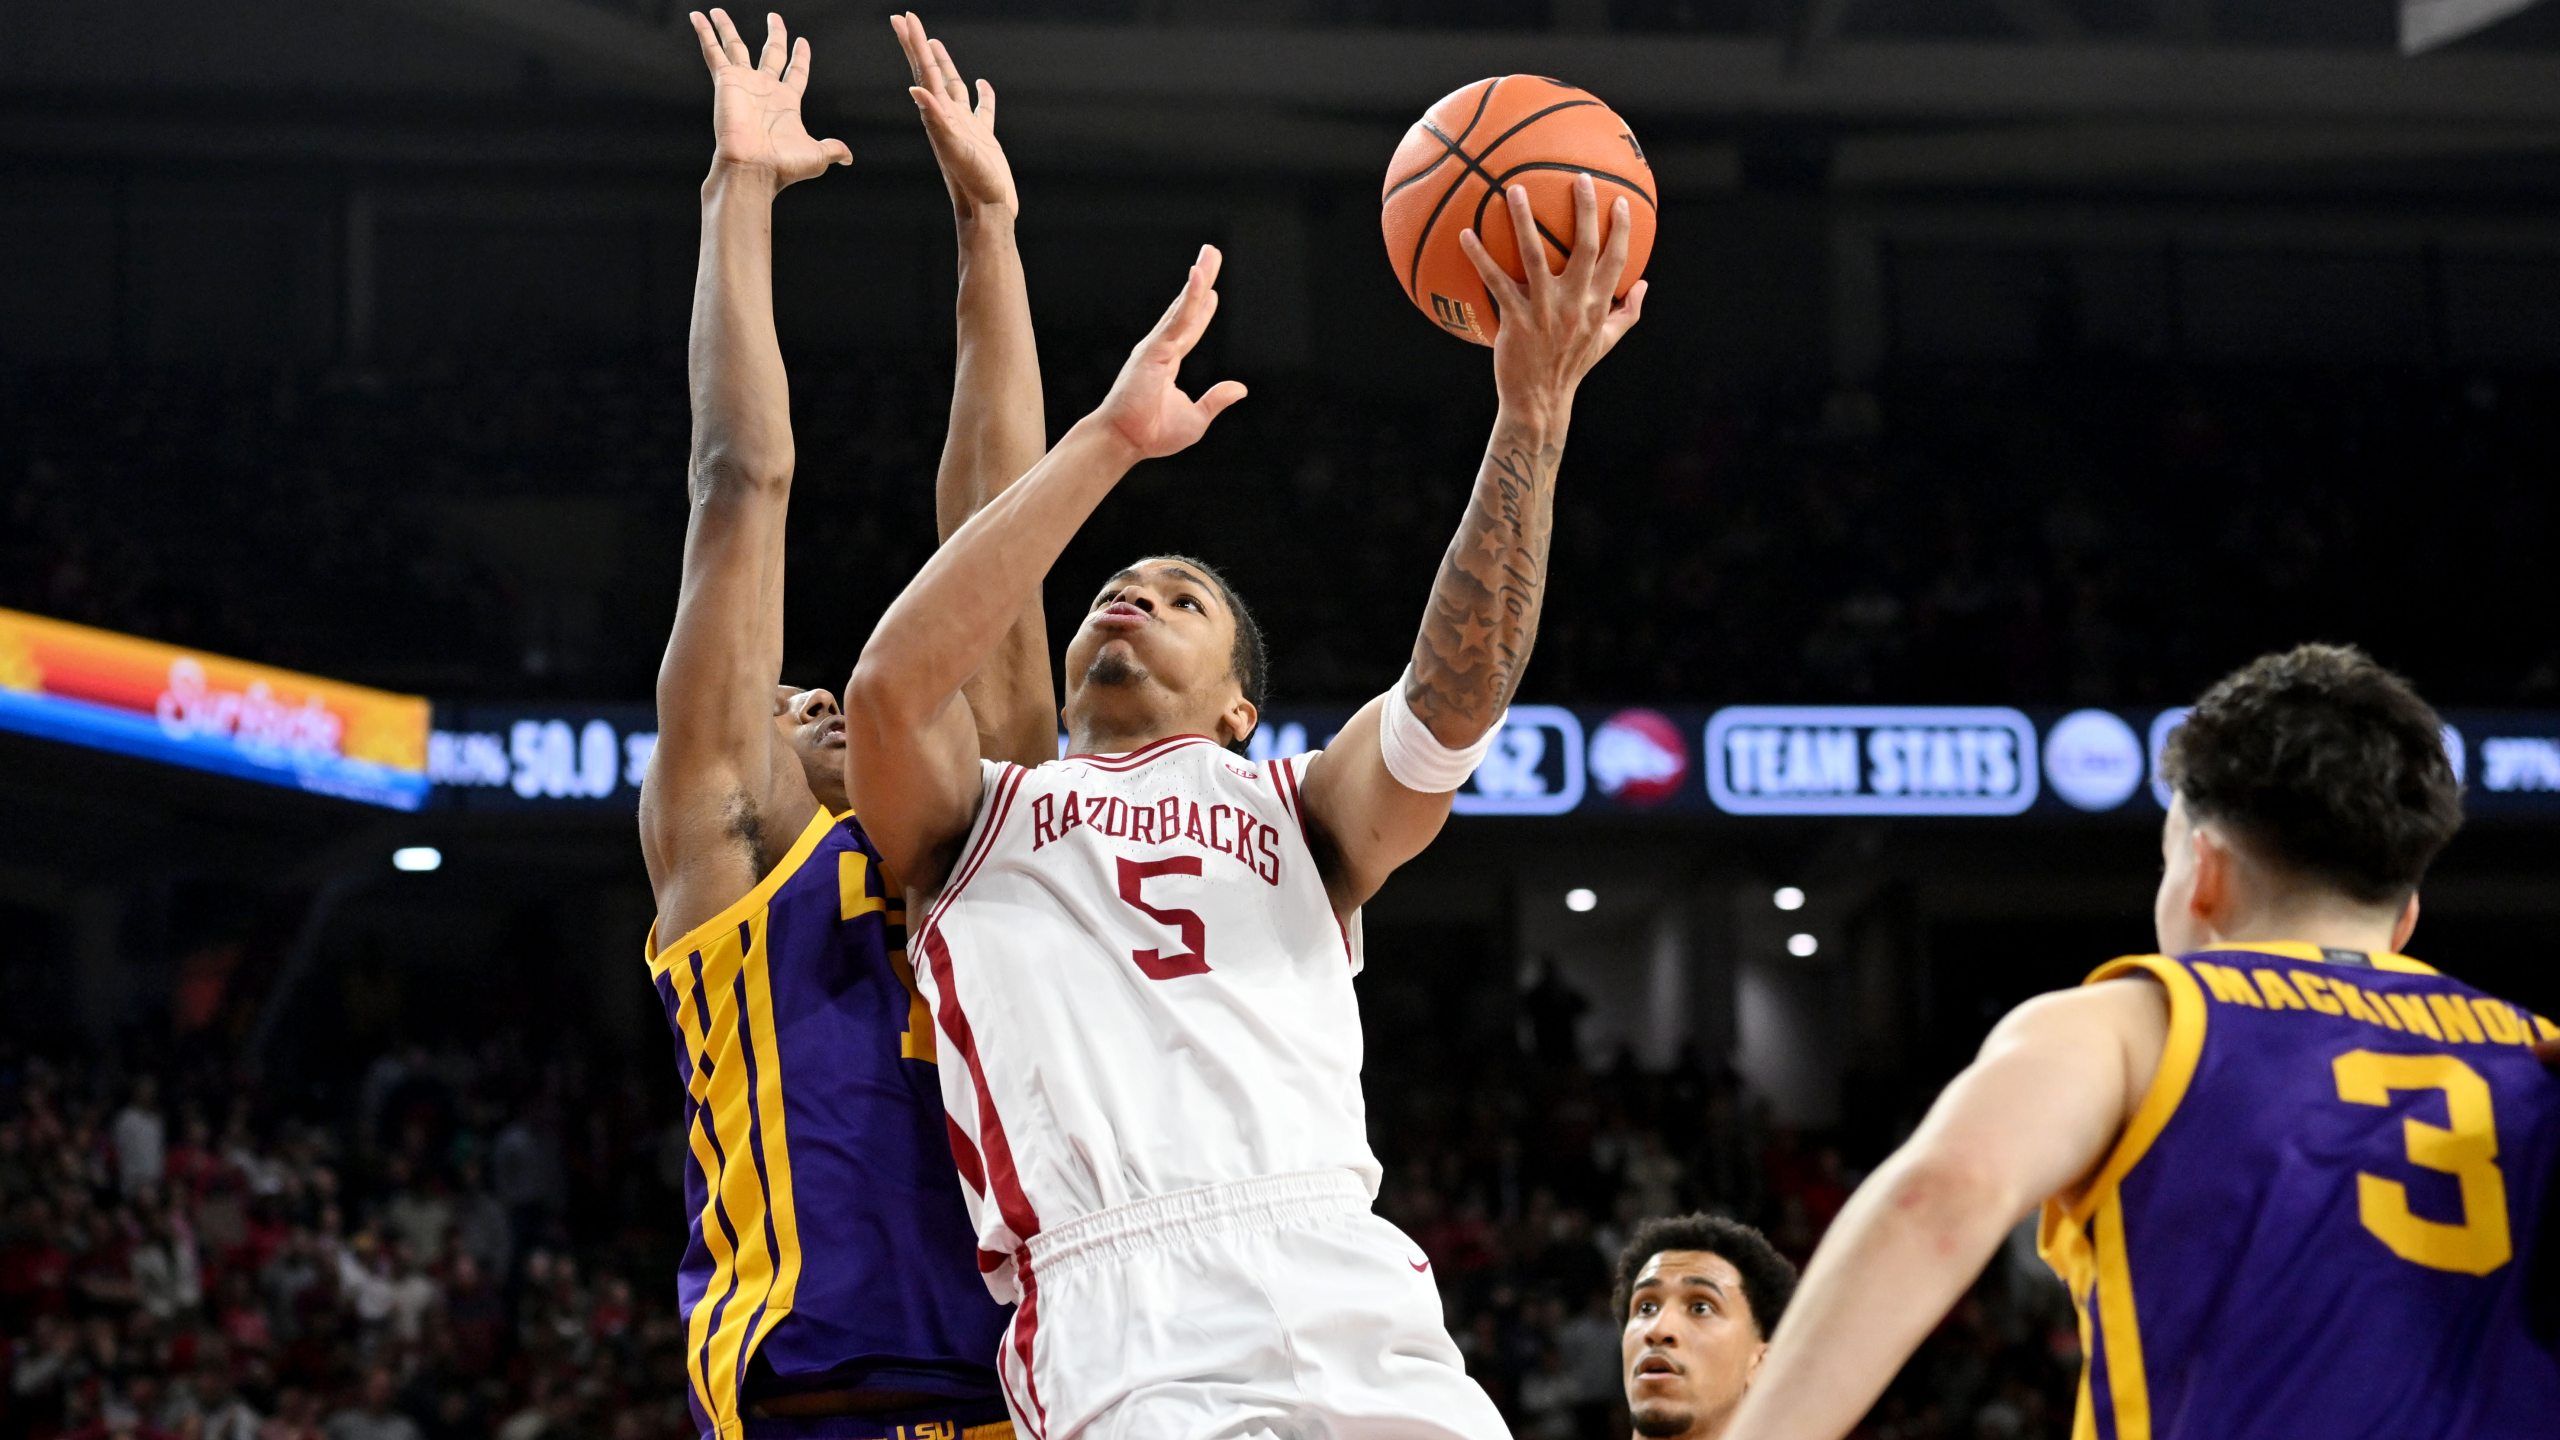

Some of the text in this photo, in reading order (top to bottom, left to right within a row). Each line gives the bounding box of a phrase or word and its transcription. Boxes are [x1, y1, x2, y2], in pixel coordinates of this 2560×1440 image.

[511, 718, 618, 799] 50.0
[1727, 727, 2017, 796] TEAM STATS
[1032, 790, 1280, 887] RAZORBACKS
[1115, 855, 1215, 981] 5
[2331, 1048, 2513, 1278] 3
